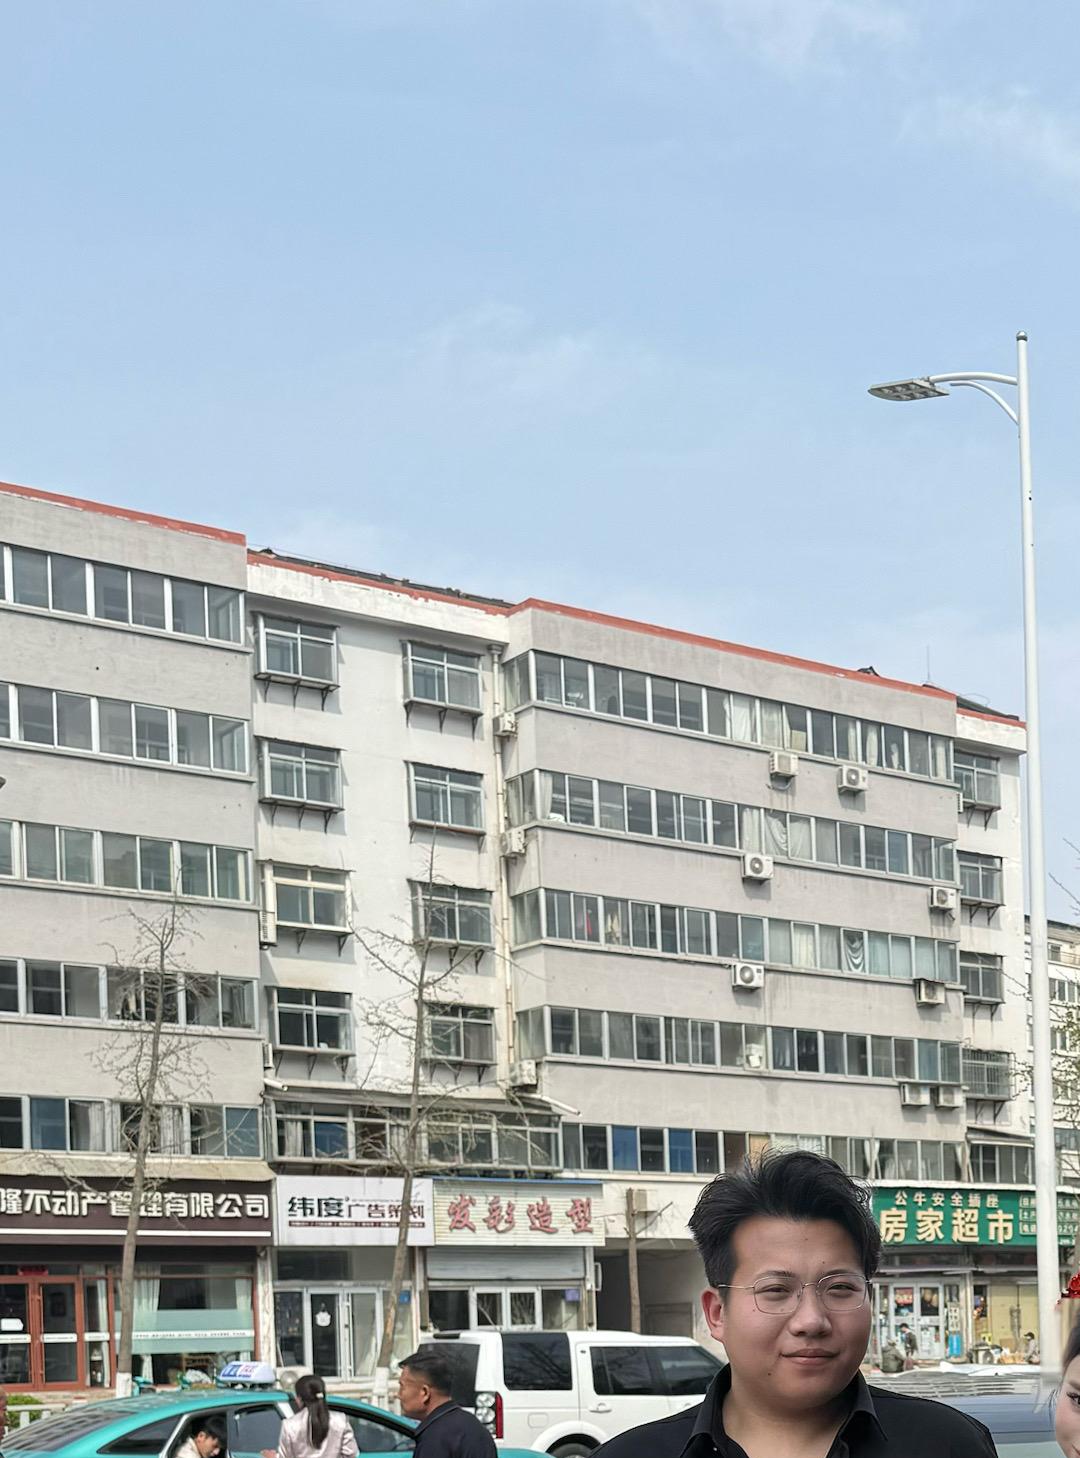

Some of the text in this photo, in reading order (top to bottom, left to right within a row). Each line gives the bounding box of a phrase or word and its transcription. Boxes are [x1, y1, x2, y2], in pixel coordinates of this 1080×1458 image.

[288, 1197, 344, 1218] 纬度
[894, 1191, 999, 1208] 公牛安全插座
